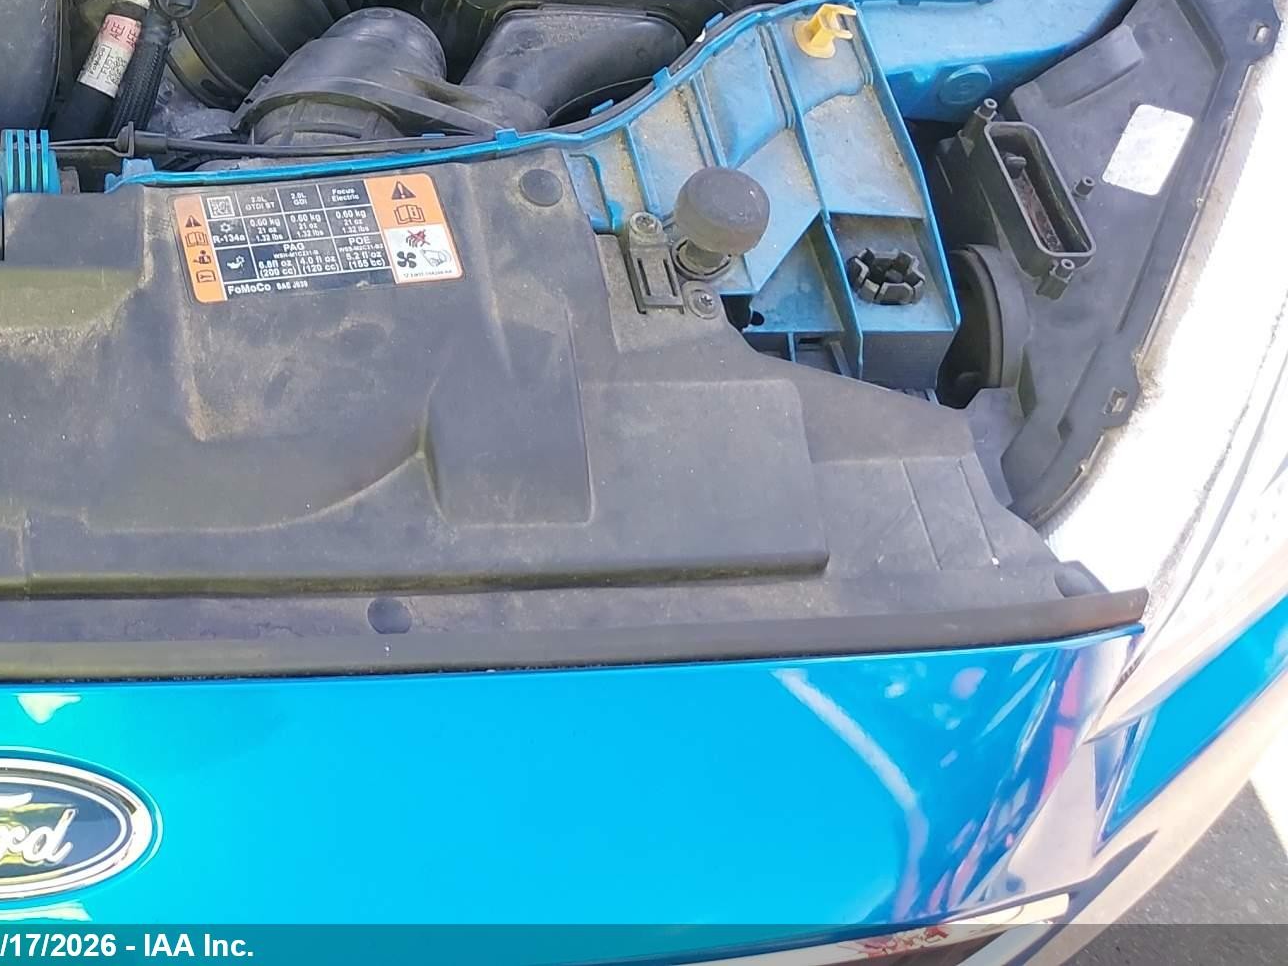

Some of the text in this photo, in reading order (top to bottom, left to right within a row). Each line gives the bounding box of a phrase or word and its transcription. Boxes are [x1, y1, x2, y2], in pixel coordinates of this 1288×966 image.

[291, 192, 307, 200] 2.0L
[331, 194, 360, 202] Electric
[290, 213, 322, 223] 0.60 kg
[336, 209, 367, 219] 0.60 kg
[249, 217, 281, 227] 0.60 kg
[256, 234, 271, 242] 1.32
[297, 230, 312, 238] 1.32
[213, 234, 246, 244] R-134a
[348, 236, 371, 245] POE
[283, 243, 305, 252] PAG
[300, 256, 315, 265] 4.0
[346, 253, 360, 261] 5.2
[370, 257, 386, 267] cc)
[260, 266, 297, 278] (200 cc)
[303, 262, 340, 275] (120 cc)
[228, 283, 272, 295] FoMoCo
